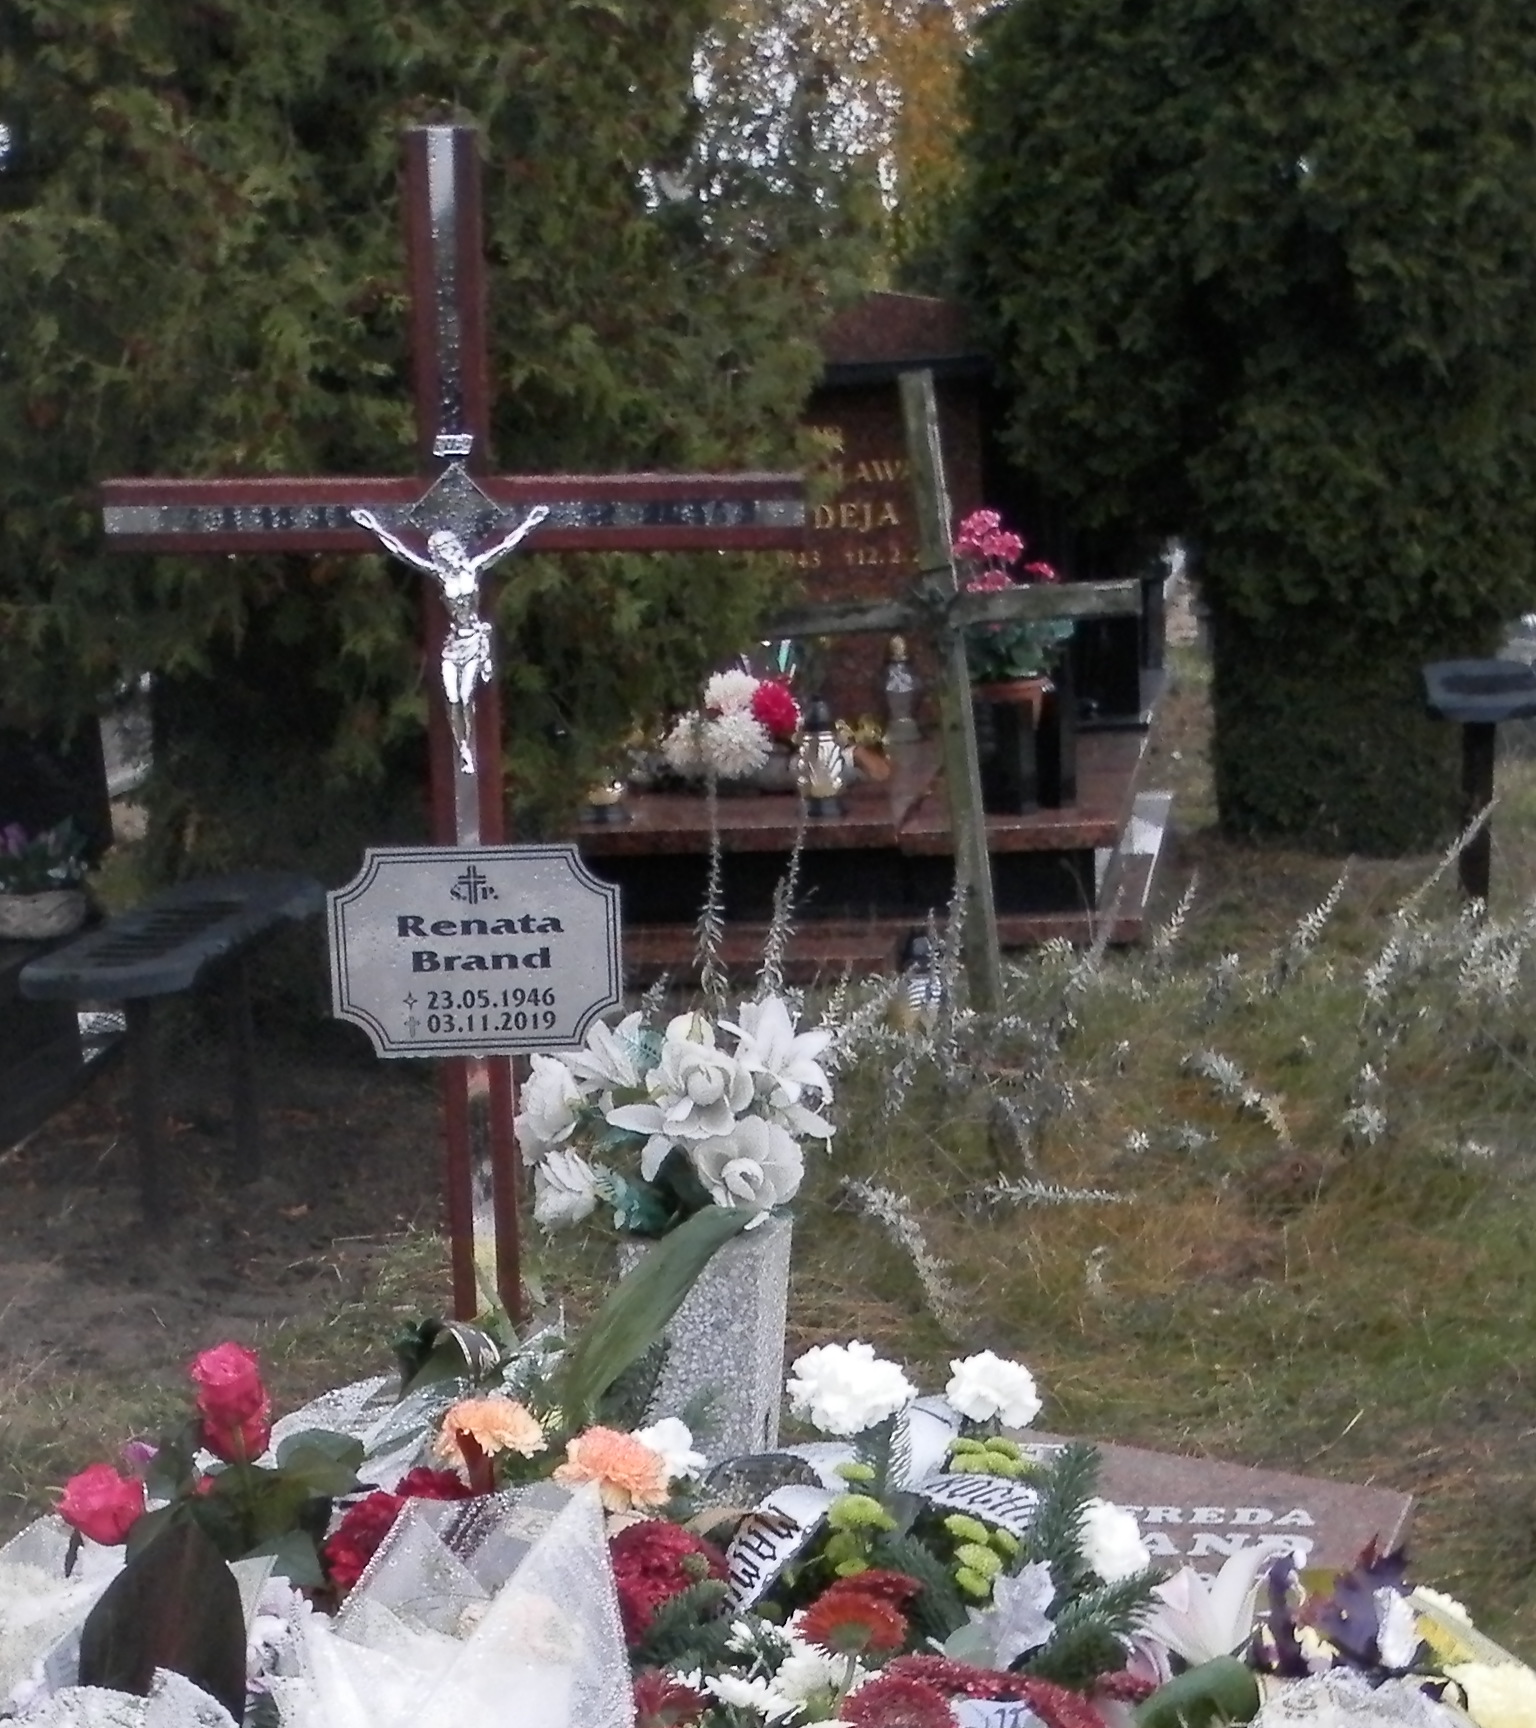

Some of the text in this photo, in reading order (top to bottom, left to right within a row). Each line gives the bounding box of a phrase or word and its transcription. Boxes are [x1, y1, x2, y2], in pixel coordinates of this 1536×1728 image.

[397, 914, 565, 939] Renata
[412, 947, 553, 973] Brand
[427, 986, 557, 1010] 23.05.1946
[427, 1010, 557, 1034] 03.11.2019
